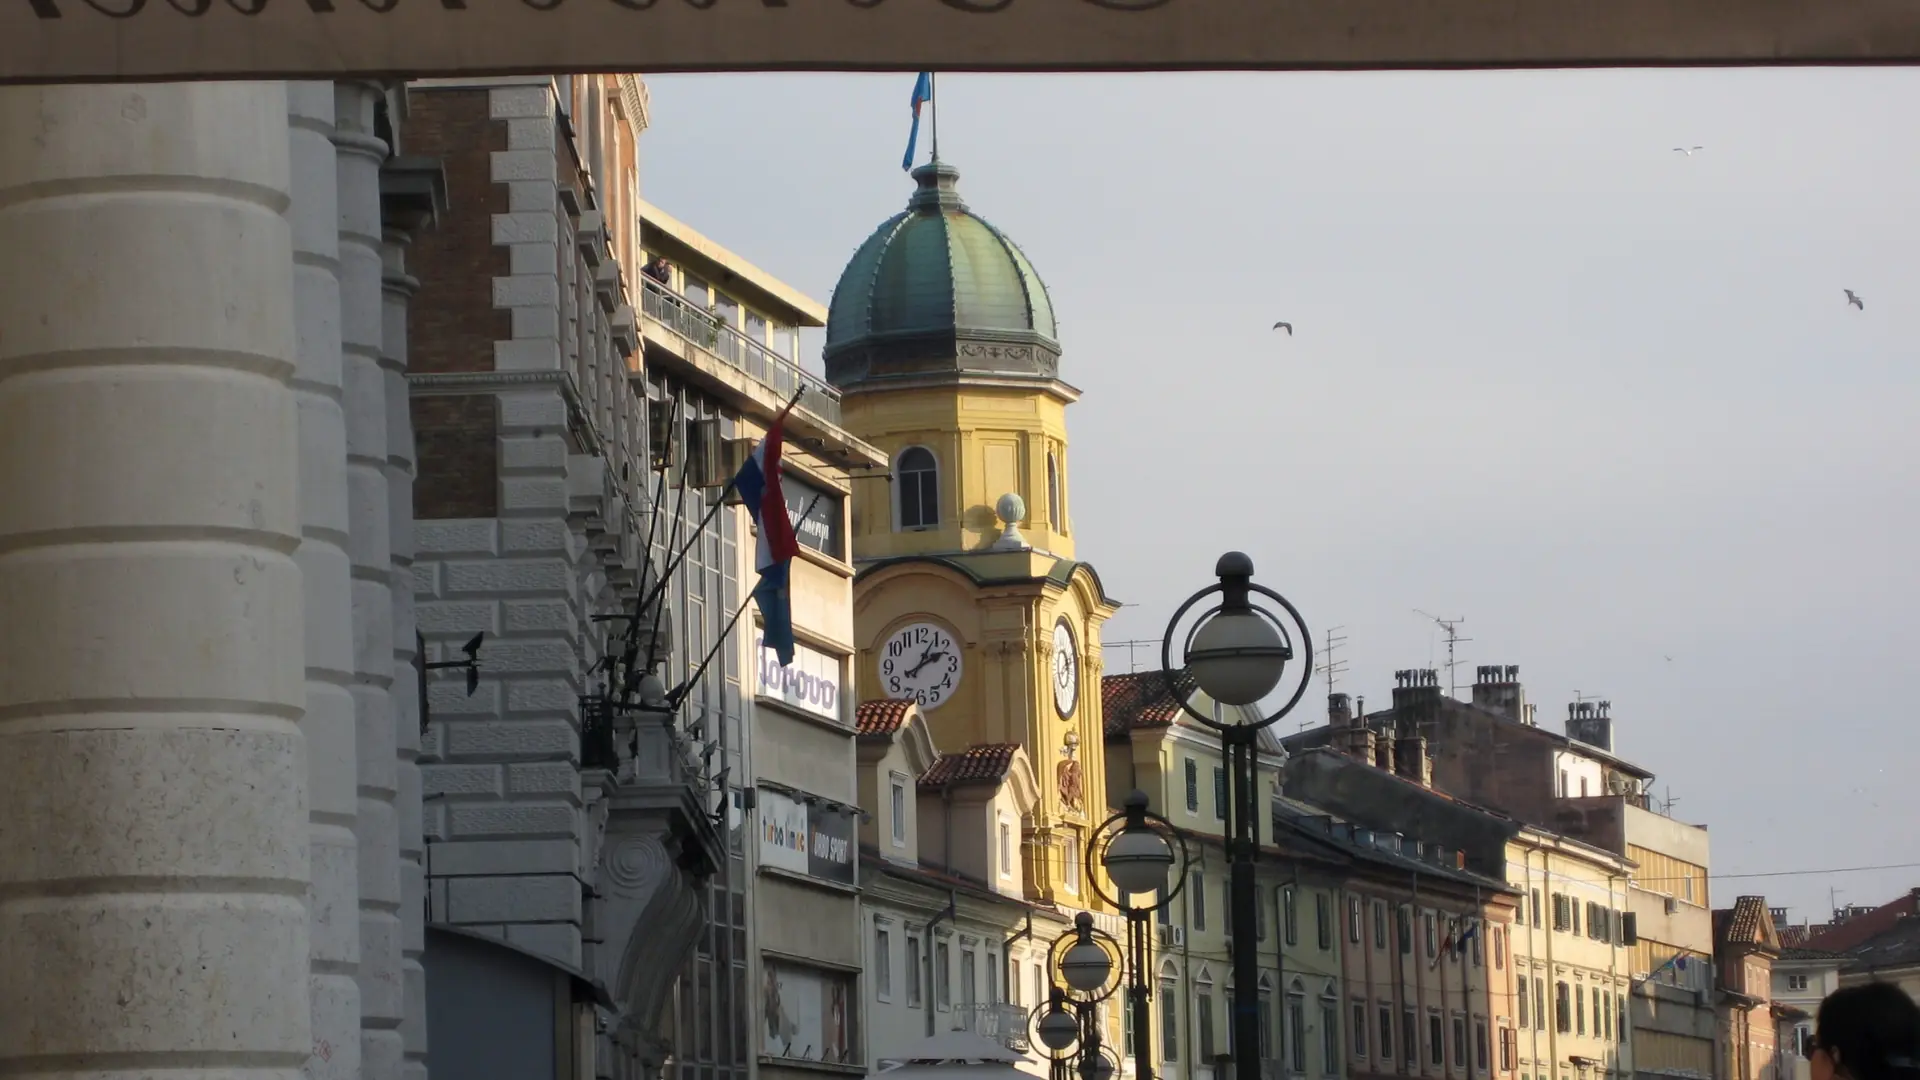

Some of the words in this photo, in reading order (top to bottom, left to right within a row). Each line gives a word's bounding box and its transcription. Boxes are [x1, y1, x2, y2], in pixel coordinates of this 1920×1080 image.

[902, 631, 912, 649] 11
[915, 627, 929, 644] 12
[933, 631, 939, 648] 1
[888, 640, 903, 657] 10
[941, 638, 951, 655] 2
[883, 658, 894, 676] 9
[948, 655, 958, 673] 3
[889, 675, 901, 693] 8
[941, 672, 952, 689] 4
[904, 687, 914, 699] 7
[915, 688, 927, 706] 6
[929, 684, 941, 703] 5
[830, 836, 848, 864] SPORT
